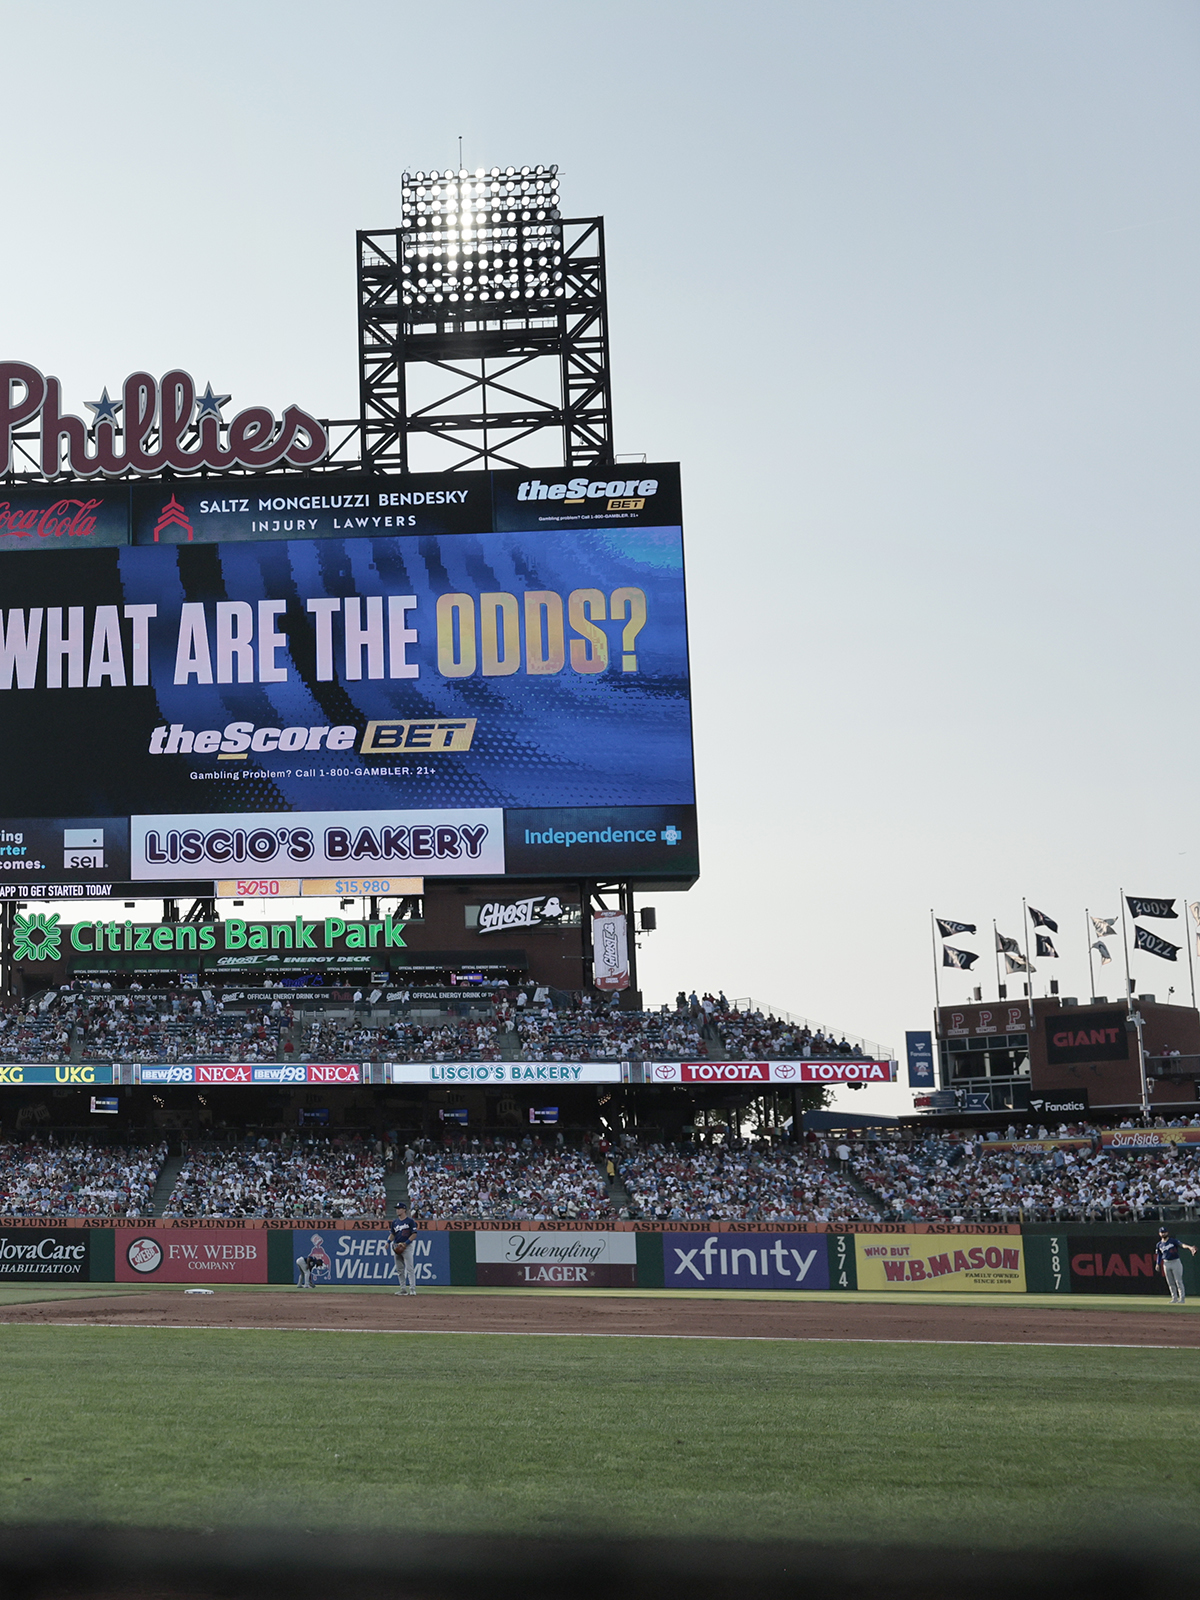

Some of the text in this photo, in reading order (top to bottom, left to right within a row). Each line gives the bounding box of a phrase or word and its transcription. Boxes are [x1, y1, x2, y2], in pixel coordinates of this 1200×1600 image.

[517, 478, 659, 501] theScore
[200, 490, 469, 514] SALTZ MONGELUZZI BENDESKY
[609, 499, 643, 510] BET
[252, 515, 417, 532] INJURY LAWYERS
[173, 599, 287, 686] ARE
[307, 596, 419, 682] THE
[436, 586, 647, 679] ODDS?
[149, 721, 467, 755] theScore BET
[190, 766, 436, 781] Gambling Problem? Call 1-800-GAMBLER. 21+
[145, 824, 490, 864] LISCIO'S BAKERY
[524, 827, 656, 847] Independence
[0, 886, 16, 897] APP
[18, 886, 28, 897] TO
[30, 886, 46, 897] GET
[47, 885, 84, 896] STARTED
[85, 885, 113, 896] TODAY
[335, 880, 390, 894] $15,980
[479, 896, 546, 933] GHOST
[1133, 900, 1168, 916] 2009
[70, 914, 408, 951] Citizens Bank Park
[1139, 930, 1171, 957] 2022
[1052, 1028, 1120, 1047] GIANT
[55, 1067, 95, 1083] UKG
[199, 1067, 251, 1082] NECA
[310, 1067, 359, 1082] NECA
[430, 1065, 582, 1081] LISCIO'S BAKERY
[688, 1065, 763, 1080] TOYOTA
[807, 1064, 884, 1079] TOYOTA
[1045, 1101, 1085, 1112] Fanatics
[1111, 1132, 1160, 1147] Surfside
[82, 1219, 156, 1228] ASPLUNDH
[171, 1219, 246, 1228] ASPLUNDH
[261, 1220, 336, 1229] ASPLUNDH
[444, 1221, 521, 1231] ASPLUNDH
[538, 1222, 615, 1231] ASPLUNDH
[633, 1223, 710, 1232] ASPLUNDH
[728, 1223, 808, 1232] ASPLUNDH
[825, 1224, 906, 1233] ASPLUNDH
[927, 1224, 1009, 1234] ASPLUNDH
[168, 1244, 257, 1260] F.W. WEBB
[506, 1235, 606, 1263] Yuengling
[864, 1247, 910, 1257] WHO BUT
[188, 1261, 236, 1270] COMPANY
[674, 1236, 818, 1282] xfinity
[524, 1266, 588, 1282] LAGER
